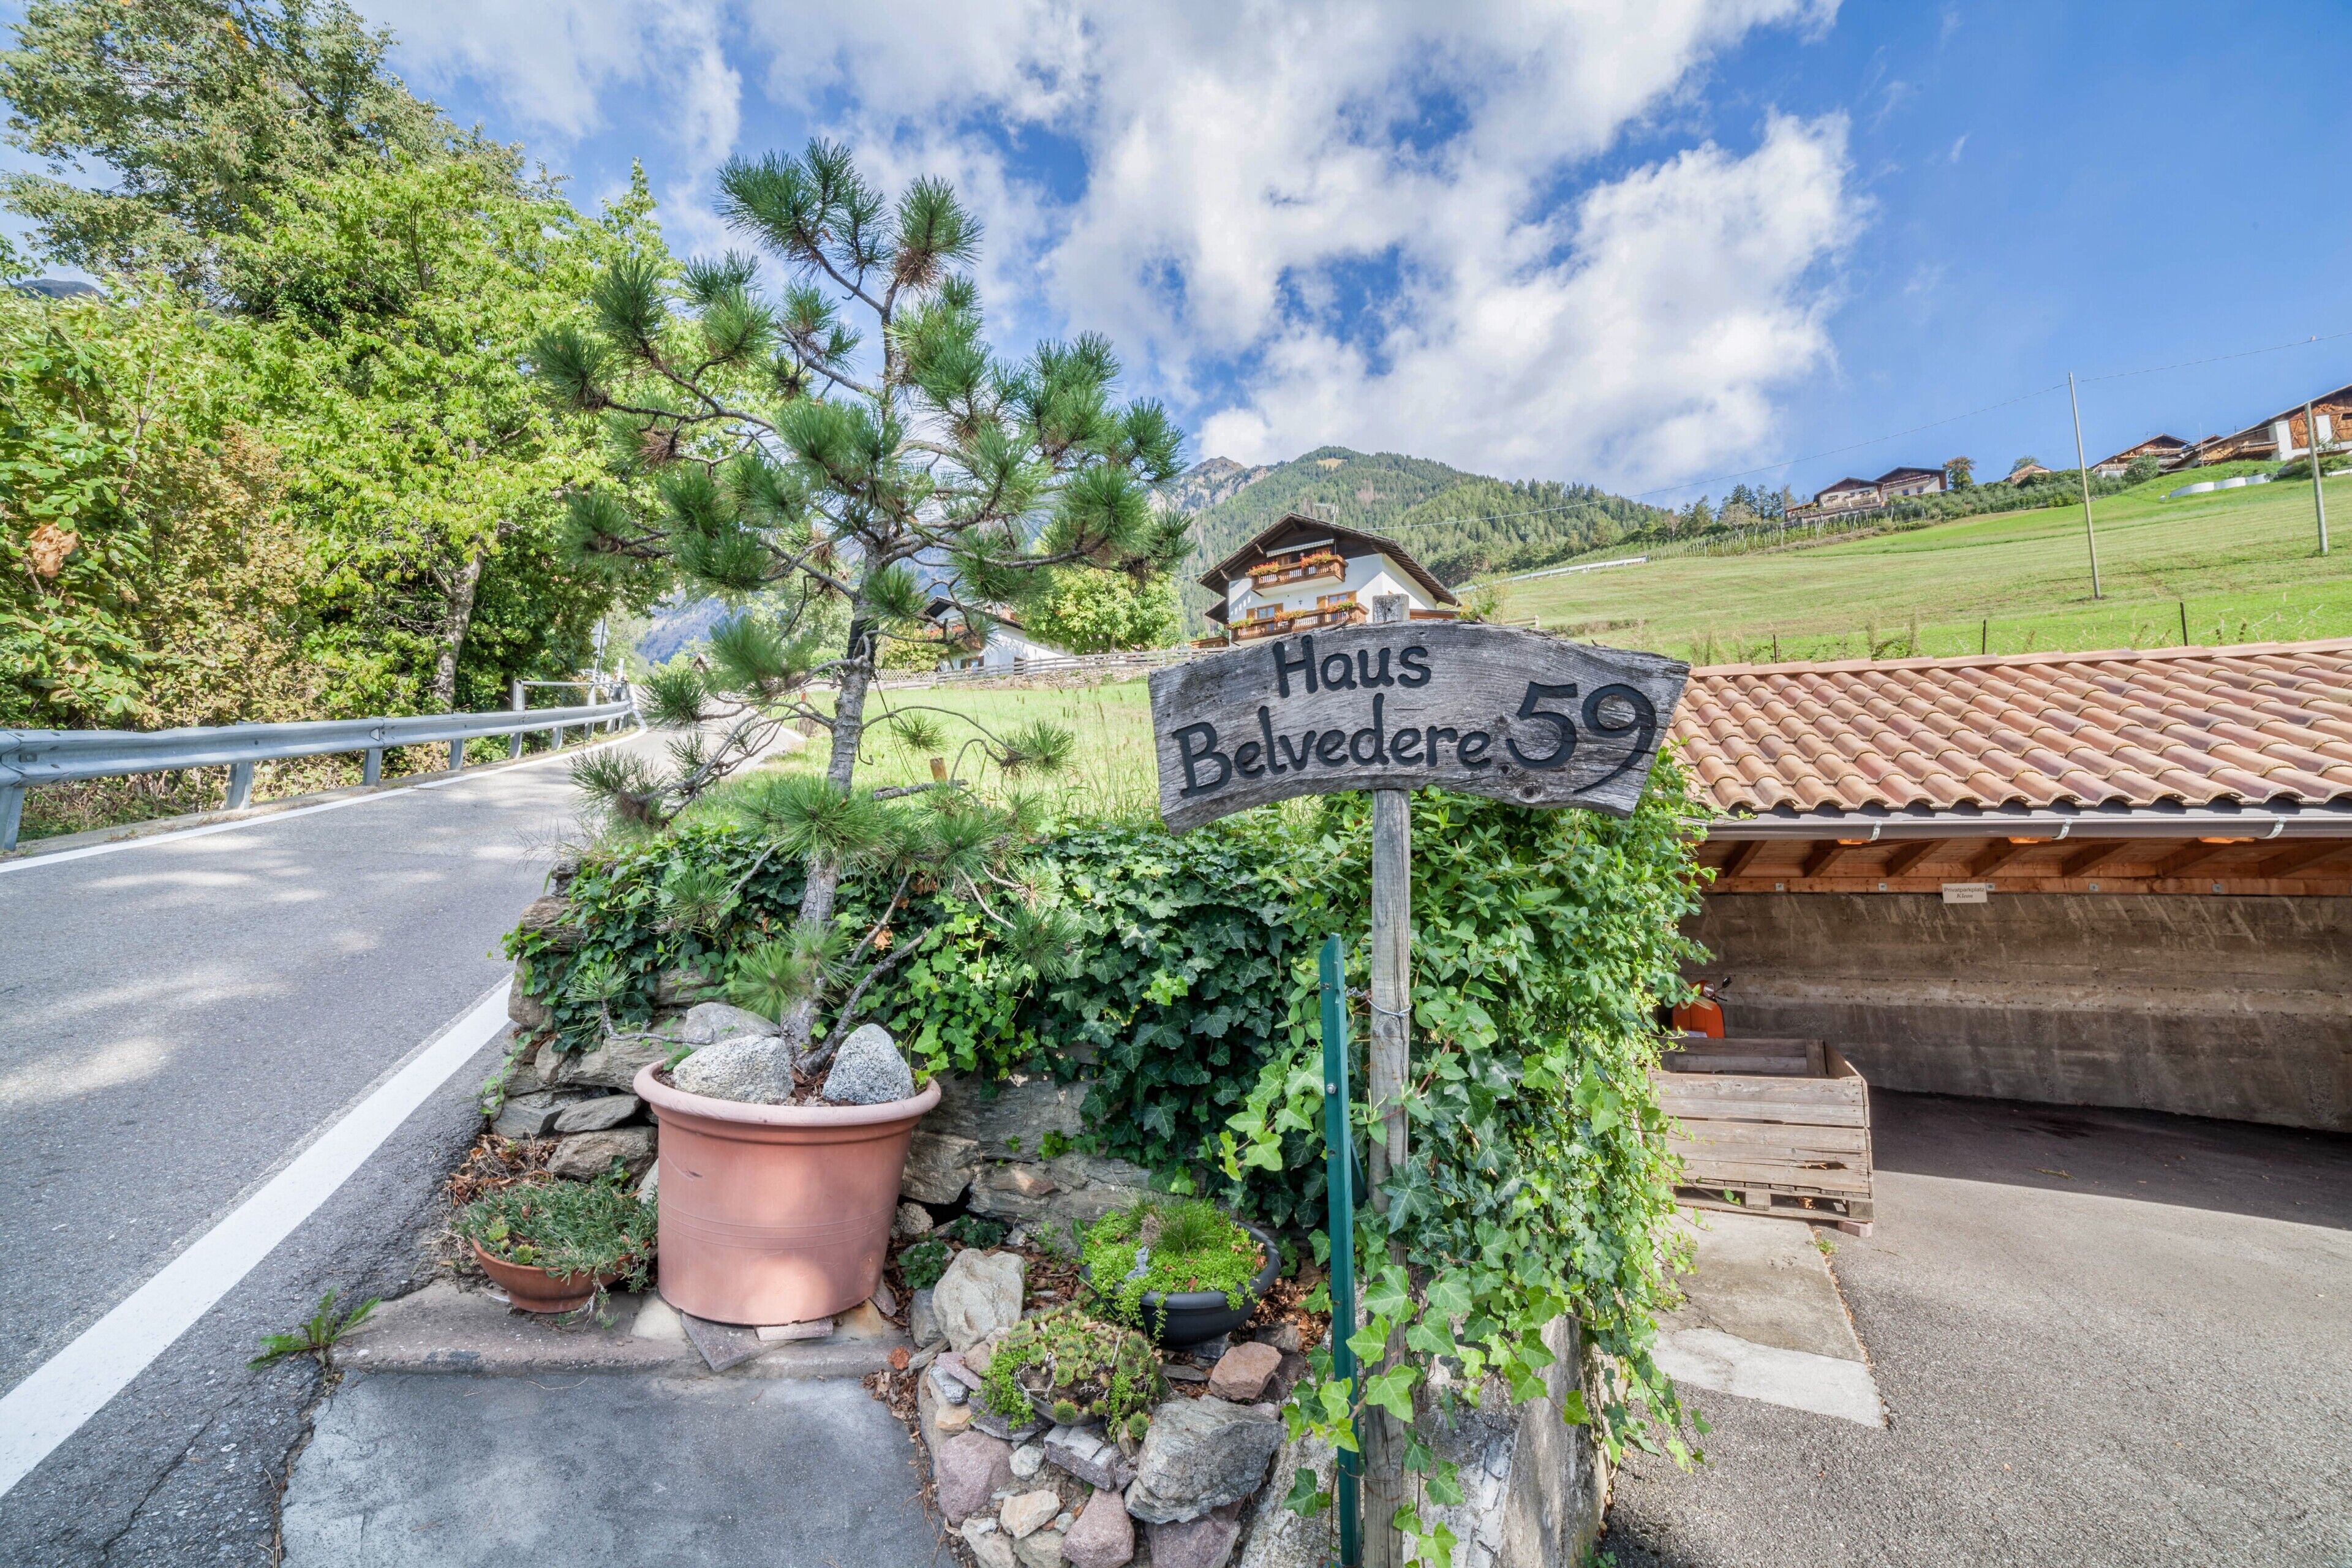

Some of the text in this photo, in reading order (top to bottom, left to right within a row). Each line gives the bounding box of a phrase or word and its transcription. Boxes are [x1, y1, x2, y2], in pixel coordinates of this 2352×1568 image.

[1272, 634, 1432, 698] Haus
[1172, 680, 1657, 799] Belvedere 59
